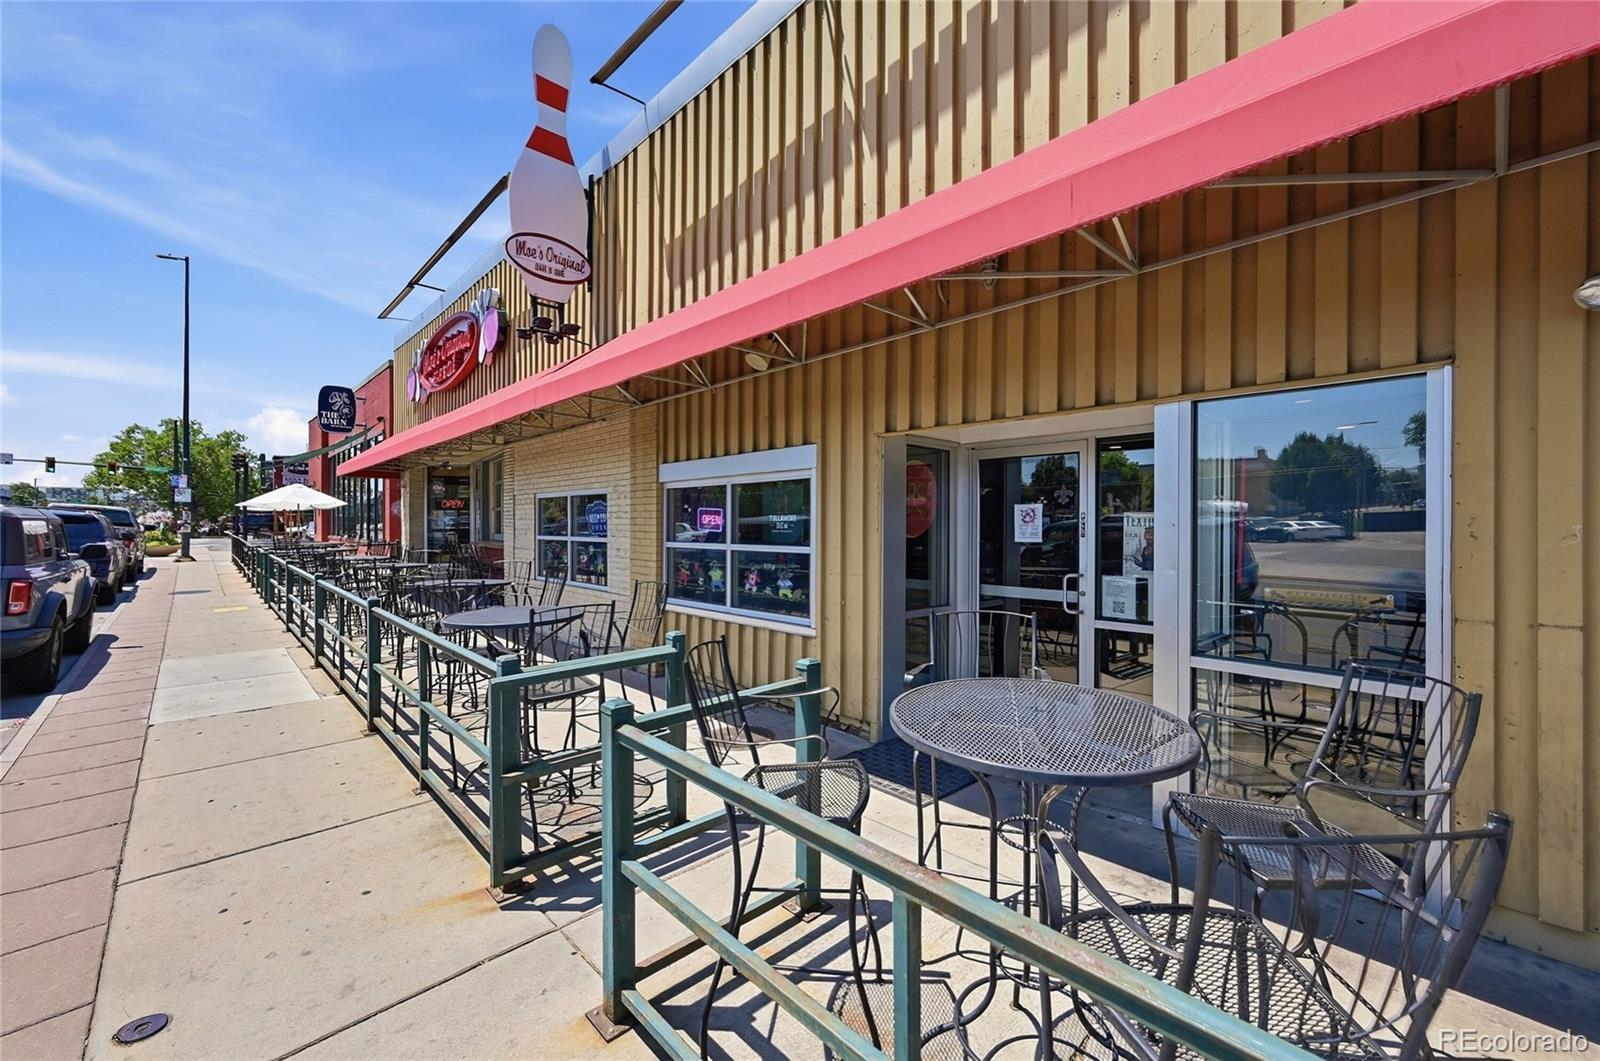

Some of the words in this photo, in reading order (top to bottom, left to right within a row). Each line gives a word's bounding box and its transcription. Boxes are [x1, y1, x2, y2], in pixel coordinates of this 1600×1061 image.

[515, 238, 543, 260] Moe's
[546, 247, 586, 274] Original
[320, 410, 340, 419] THE
[321, 417, 347, 426] BARN
[441, 499, 465, 509] OPEN
[701, 514, 722, 525] OPEN
